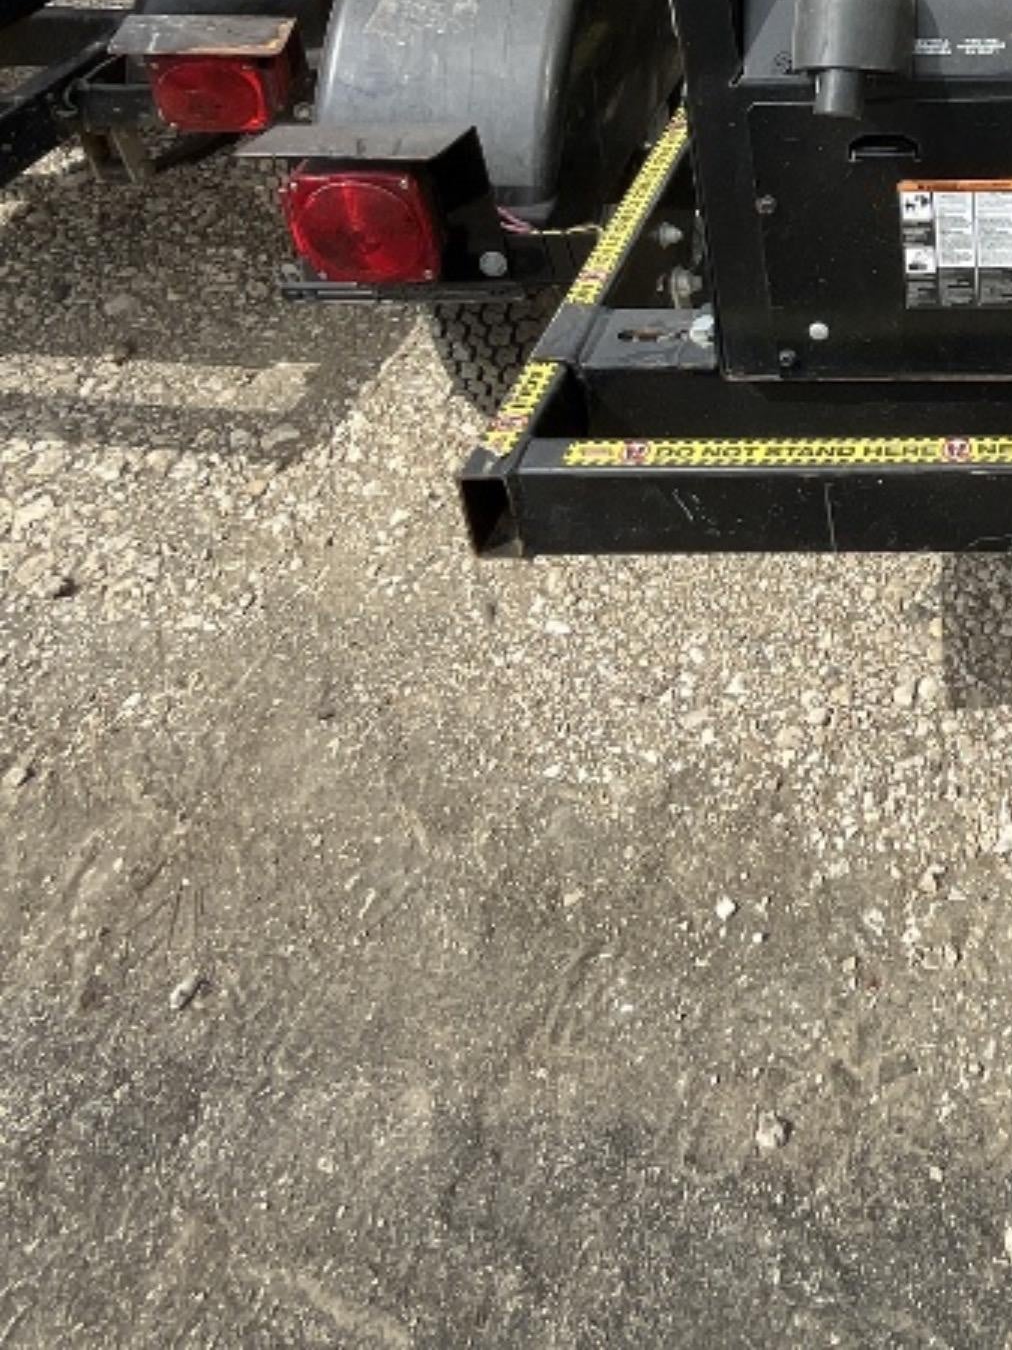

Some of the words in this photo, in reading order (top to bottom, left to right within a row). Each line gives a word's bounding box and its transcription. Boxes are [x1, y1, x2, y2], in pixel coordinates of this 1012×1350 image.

[655, 446, 695, 457] DO
[701, 446, 758, 457] NOT
[764, 446, 856, 457] STAND
[863, 445, 939, 457] HERE
